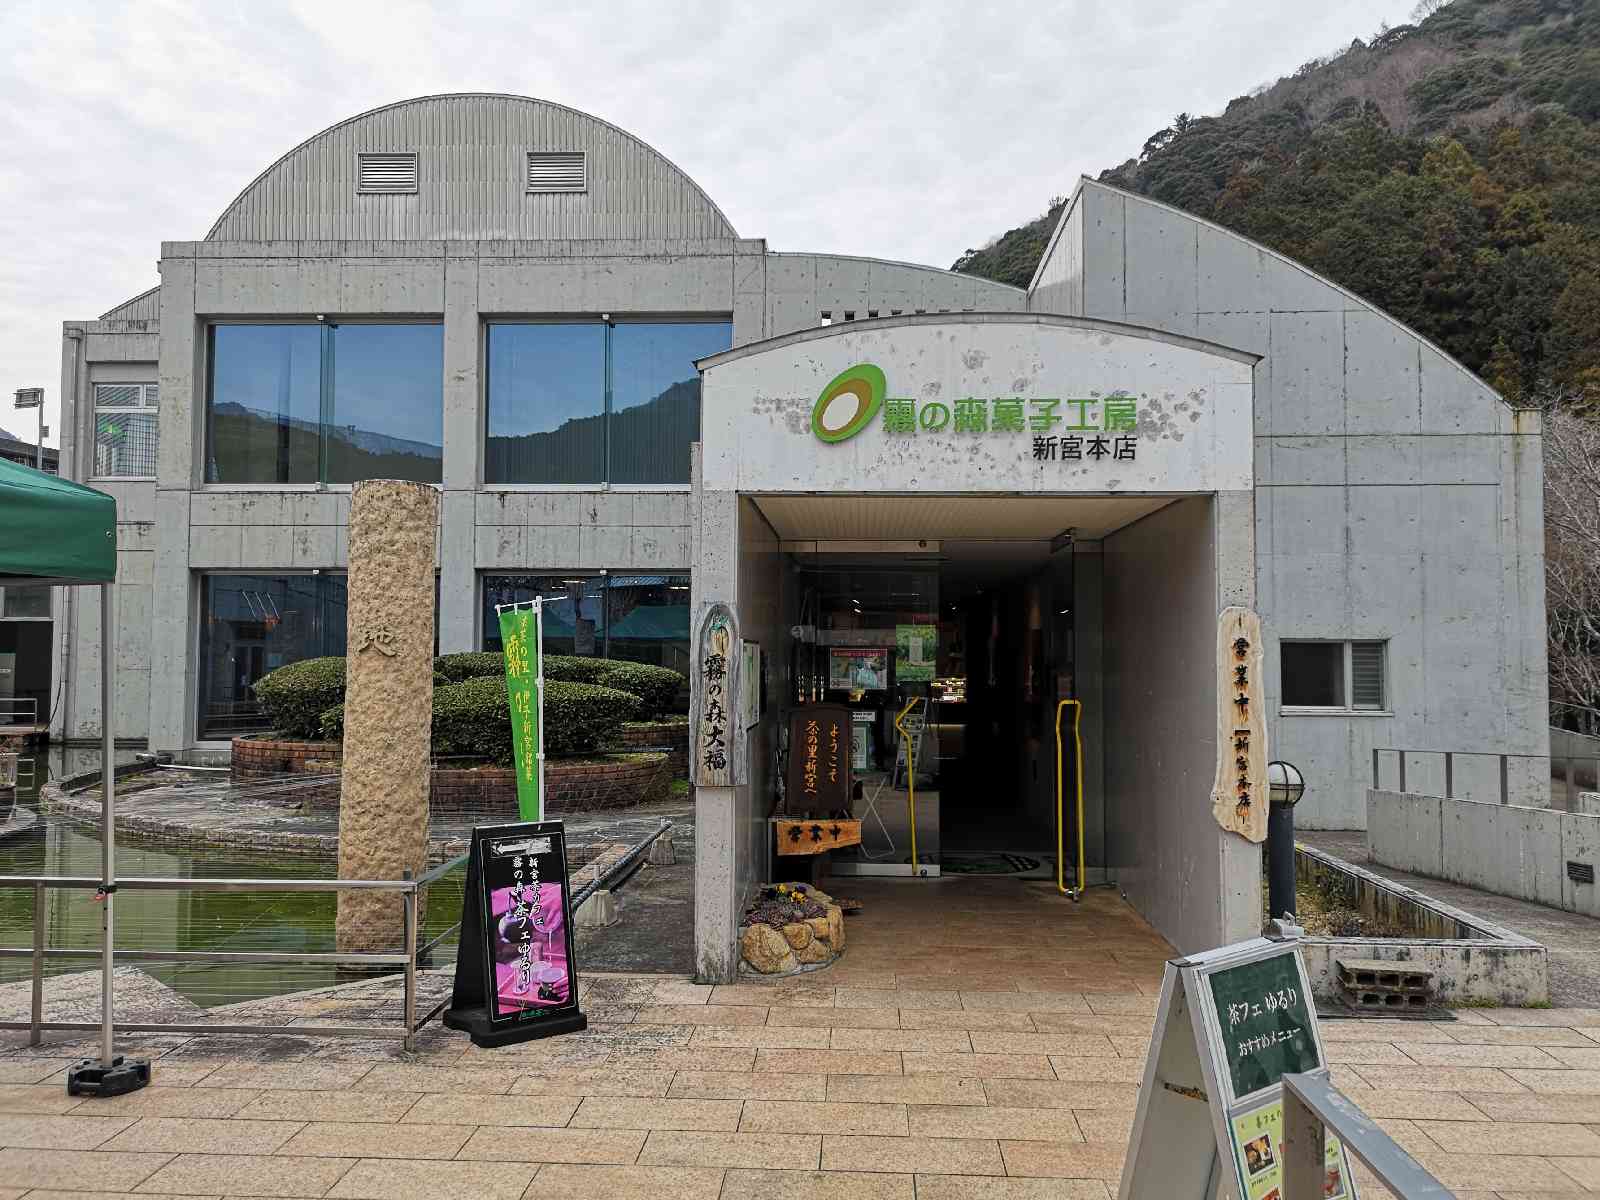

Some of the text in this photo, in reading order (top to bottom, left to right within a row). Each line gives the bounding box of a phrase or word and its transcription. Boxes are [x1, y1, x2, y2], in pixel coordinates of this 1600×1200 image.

[882, 397, 1138, 432] 霧の森菓子工房
[1032, 435, 1138, 461] 新宮本店
[703, 653, 727, 771] 霧の森大福
[1227, 987, 1297, 1025] 茶フェ ゆるり
[1238, 1027, 1301, 1057] おすすめメニュー
